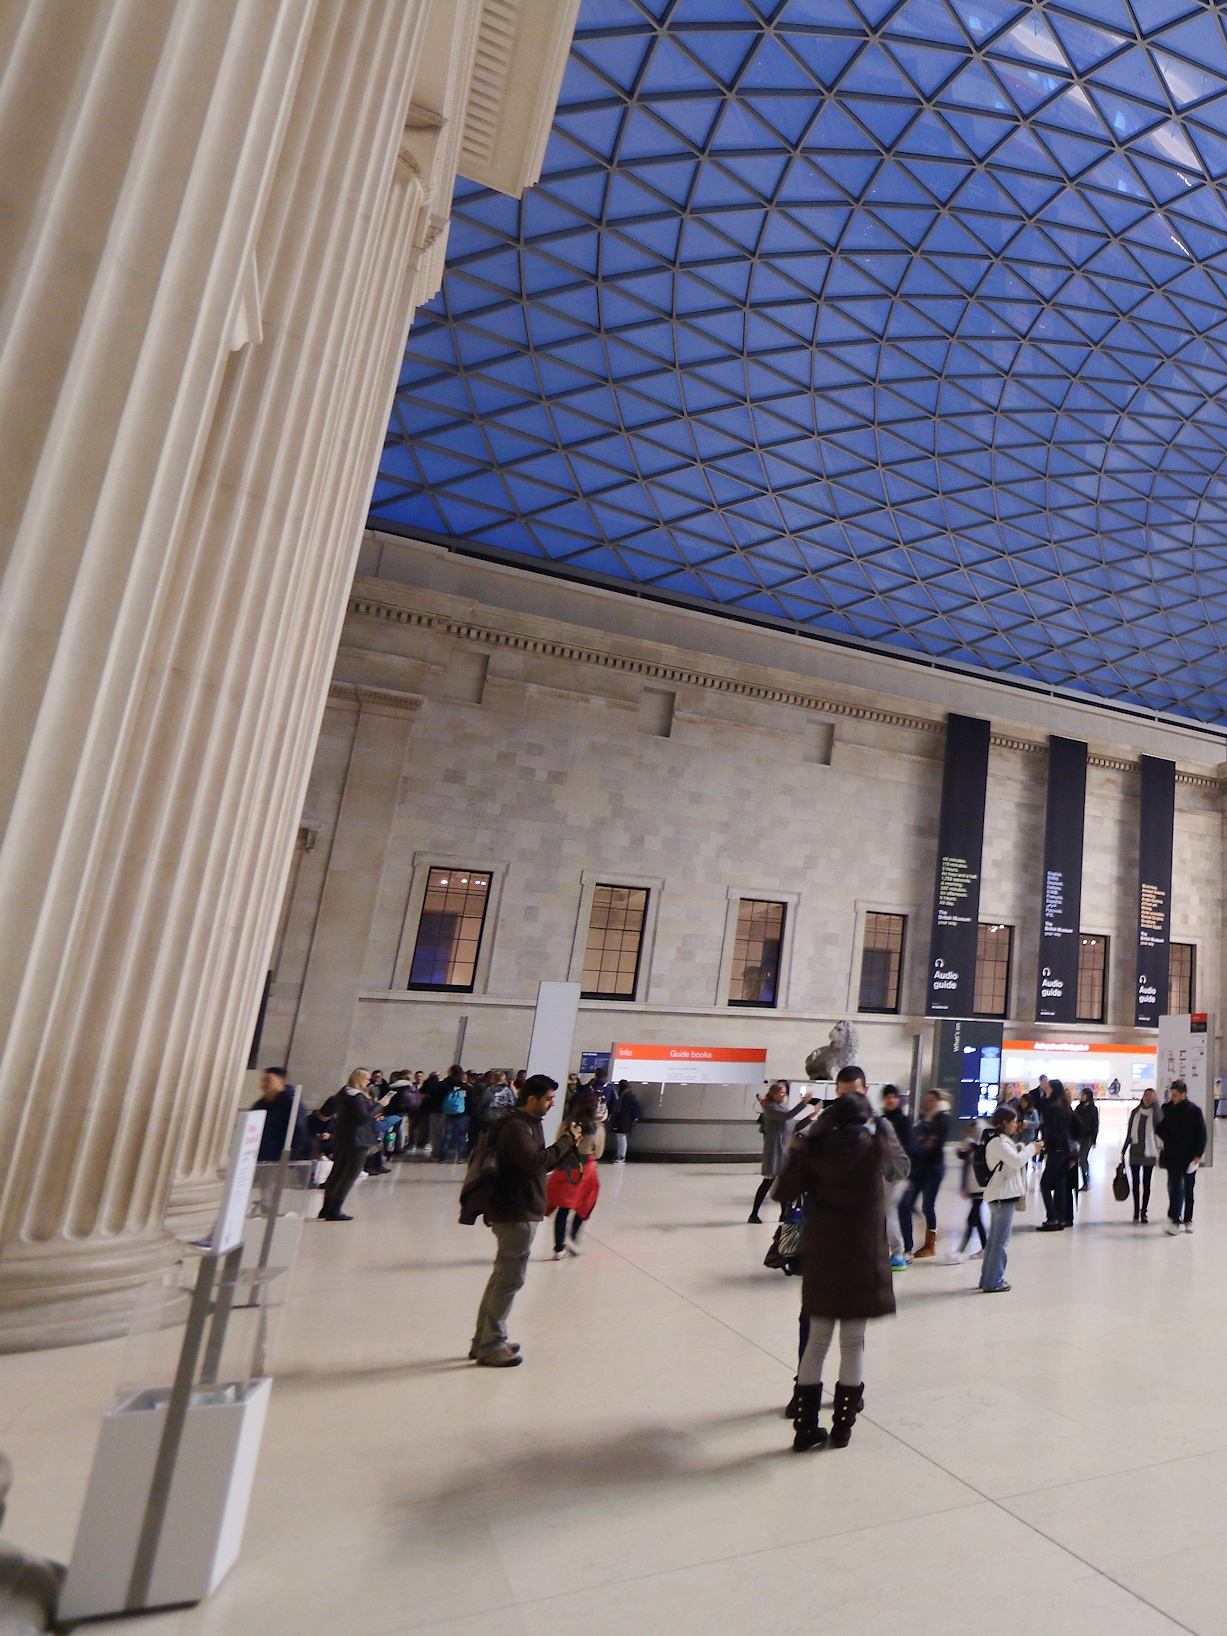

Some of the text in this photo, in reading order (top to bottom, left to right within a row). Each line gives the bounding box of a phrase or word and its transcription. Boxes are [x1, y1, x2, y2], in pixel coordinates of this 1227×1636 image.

[933, 970, 959, 980] Audio
[933, 980, 957, 990] guide
[1041, 978, 1064, 988] Audio
[1041, 988, 1062, 998] guide
[1138, 985, 1157, 995] Audio
[1138, 995, 1156, 1004] guide
[953, 1022, 961, 1053] What's on
[669, 1049, 712, 1059] Guide books
